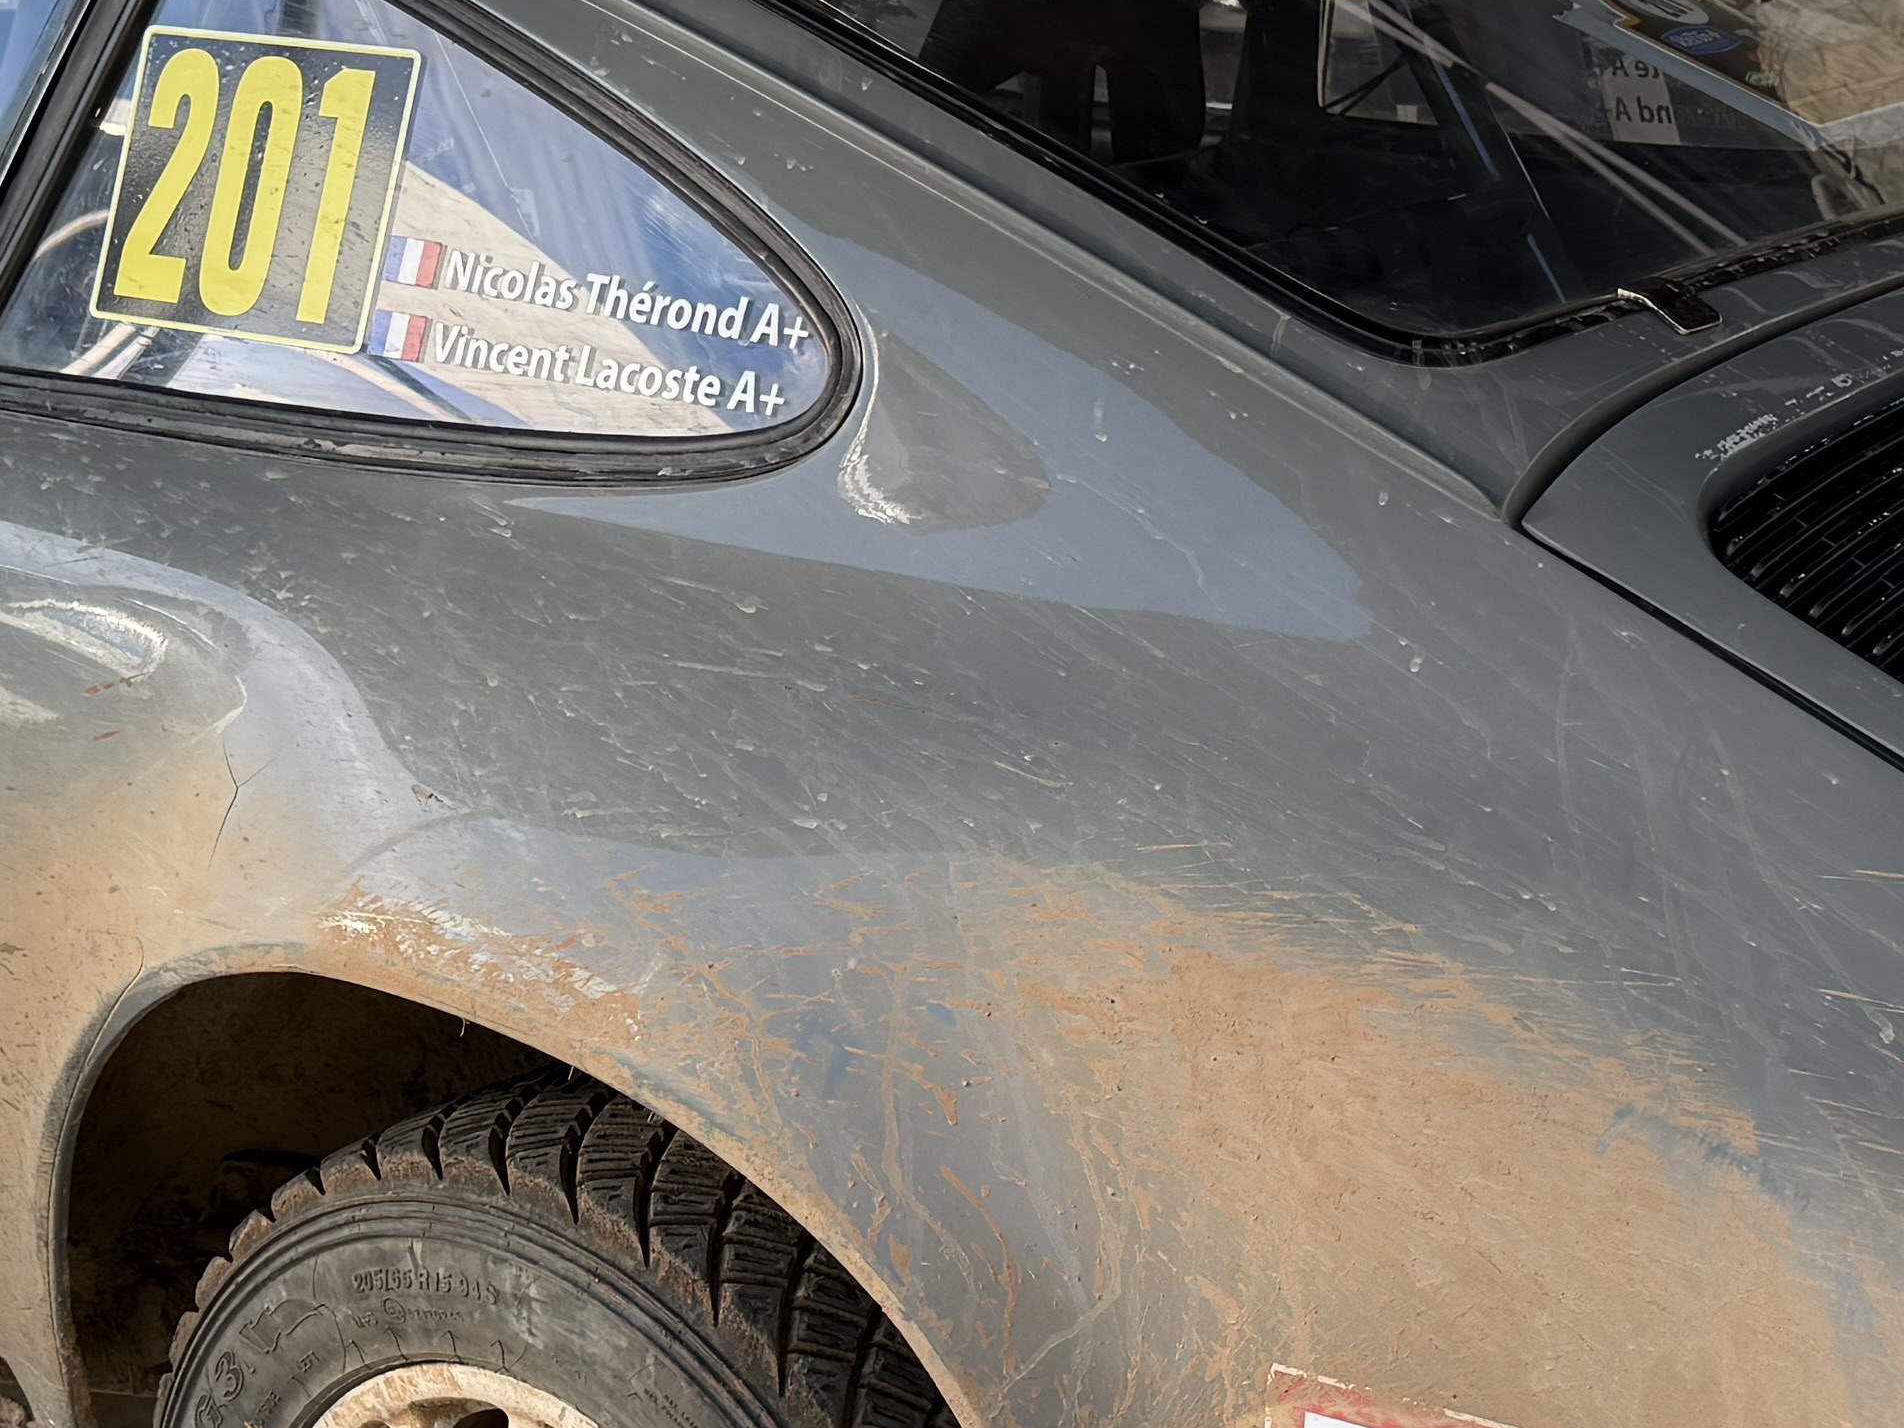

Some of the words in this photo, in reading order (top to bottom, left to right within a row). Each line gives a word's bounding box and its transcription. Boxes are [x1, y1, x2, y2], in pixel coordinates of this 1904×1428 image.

[113, 47, 377, 324] 201
[444, 248, 578, 310] Nicolas
[585, 272, 750, 339] Thérond
[752, 301, 809, 349] A+
[433, 321, 569, 382] Vincent
[574, 344, 723, 408] Lacoste
[725, 368, 786, 417] A+
